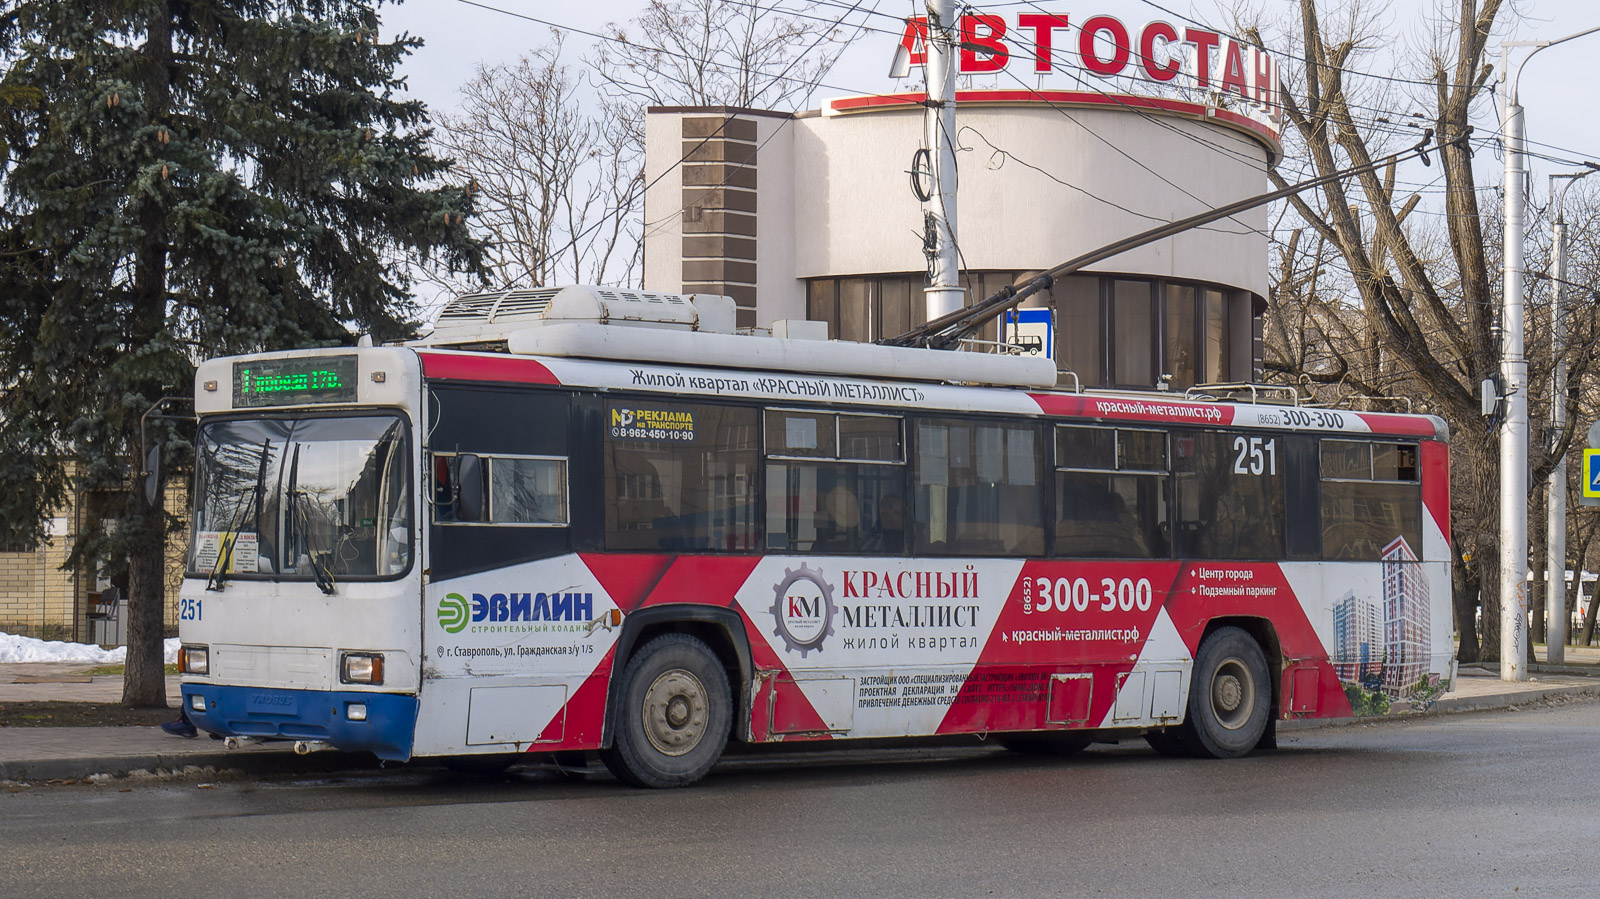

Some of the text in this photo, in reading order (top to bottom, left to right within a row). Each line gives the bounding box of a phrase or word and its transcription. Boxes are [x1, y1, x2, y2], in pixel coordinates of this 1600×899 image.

[888, 11, 1281, 124] АВТОСТАН
[629, 369, 925, 402] Жилой квартал «КРАСНЫЙ МЕТАЛЛИСТ»
[636, 409, 693, 423] РЕКЛАМА
[1096, 401, 1222, 422] красный-металлист.рф
[1257, 409, 1344, 429] (8652) 300-300
[636, 421, 694, 431] на ТРАНСПОРТЕ
[1233, 436, 1276, 476] 251
[842, 565, 980, 599] КРАСНЫЙ
[1199, 567, 1254, 582] Центр города
[1023, 576, 1033, 615] (8652)
[1036, 577, 1153, 612] 300-300
[1199, 584, 1277, 599] Подземный паркинг
[181, 599, 203, 621] 251
[472, 593, 593, 622] ЭВИЛИН
[788, 596, 820, 617] КМ
[842, 605, 980, 628] МЕТАЛЛИСТ
[471, 622, 594, 633] СТРОИТЕЛЬНЫЙ ХОЛДИН
[1012, 625, 1140, 645] красный-металлист.рф
[447, 650, 453, 658] г.
[454, 645, 503, 659] Ставрополь,
[504, 646, 516, 658] ул.
[517, 644, 567, 658] Гражданская
[581, 644, 594, 655] 1/5
[843, 634, 978, 652] жилой квартал
[859, 675, 898, 687] ЗАСТРОЙЩИК
[898, 675, 910, 685] ООО
[859, 686, 897, 698] ПРОЕКТНАЯ
[902, 685, 945, 697] ДЕКЛАРАЦИЯ
[950, 683, 959, 694] НА
[858, 697, 901, 709] ПРИВЛЕЧЕНИЕ
[901, 697, 936, 709] ДЕНЕЖНЫХ
[936, 695, 961, 707] СРЕДСТВ
